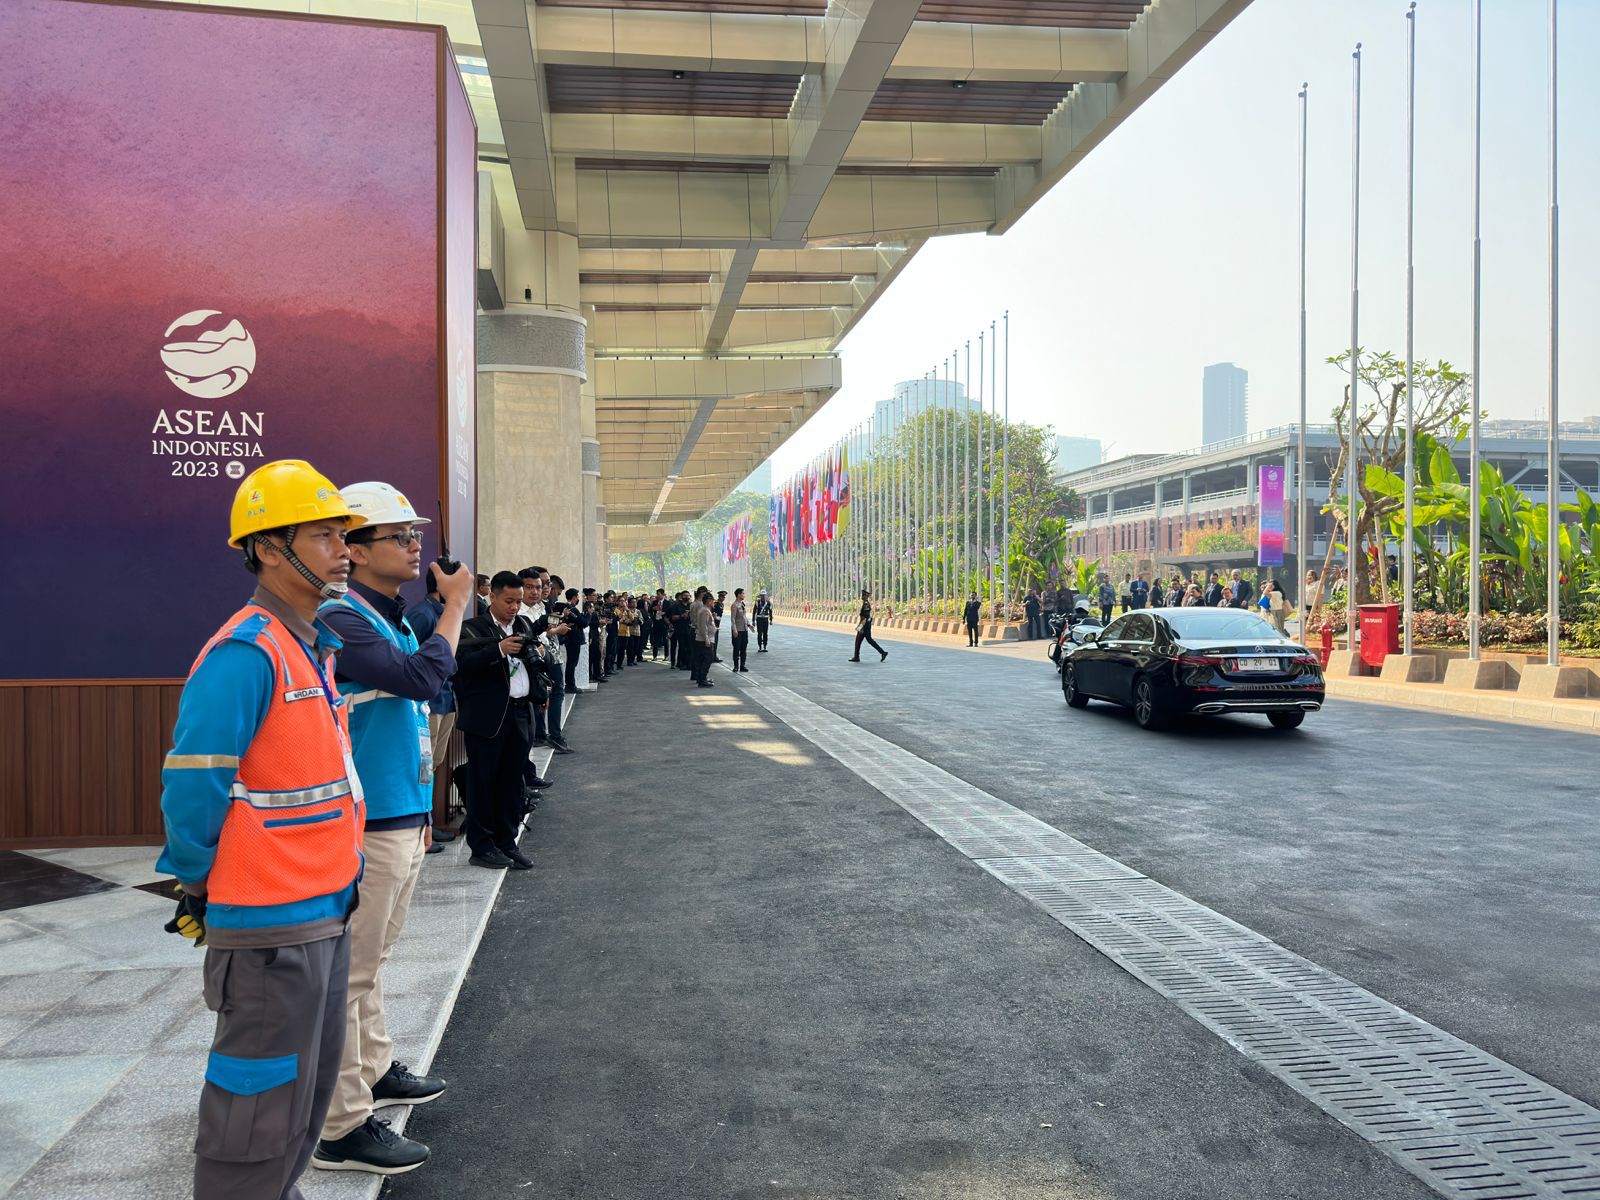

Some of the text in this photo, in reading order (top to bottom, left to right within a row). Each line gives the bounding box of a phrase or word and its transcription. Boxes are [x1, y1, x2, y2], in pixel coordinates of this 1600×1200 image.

[152, 408, 264, 436] ASEAN
[152, 440, 264, 457] INDONESIA
[171, 460, 219, 477] 2023
